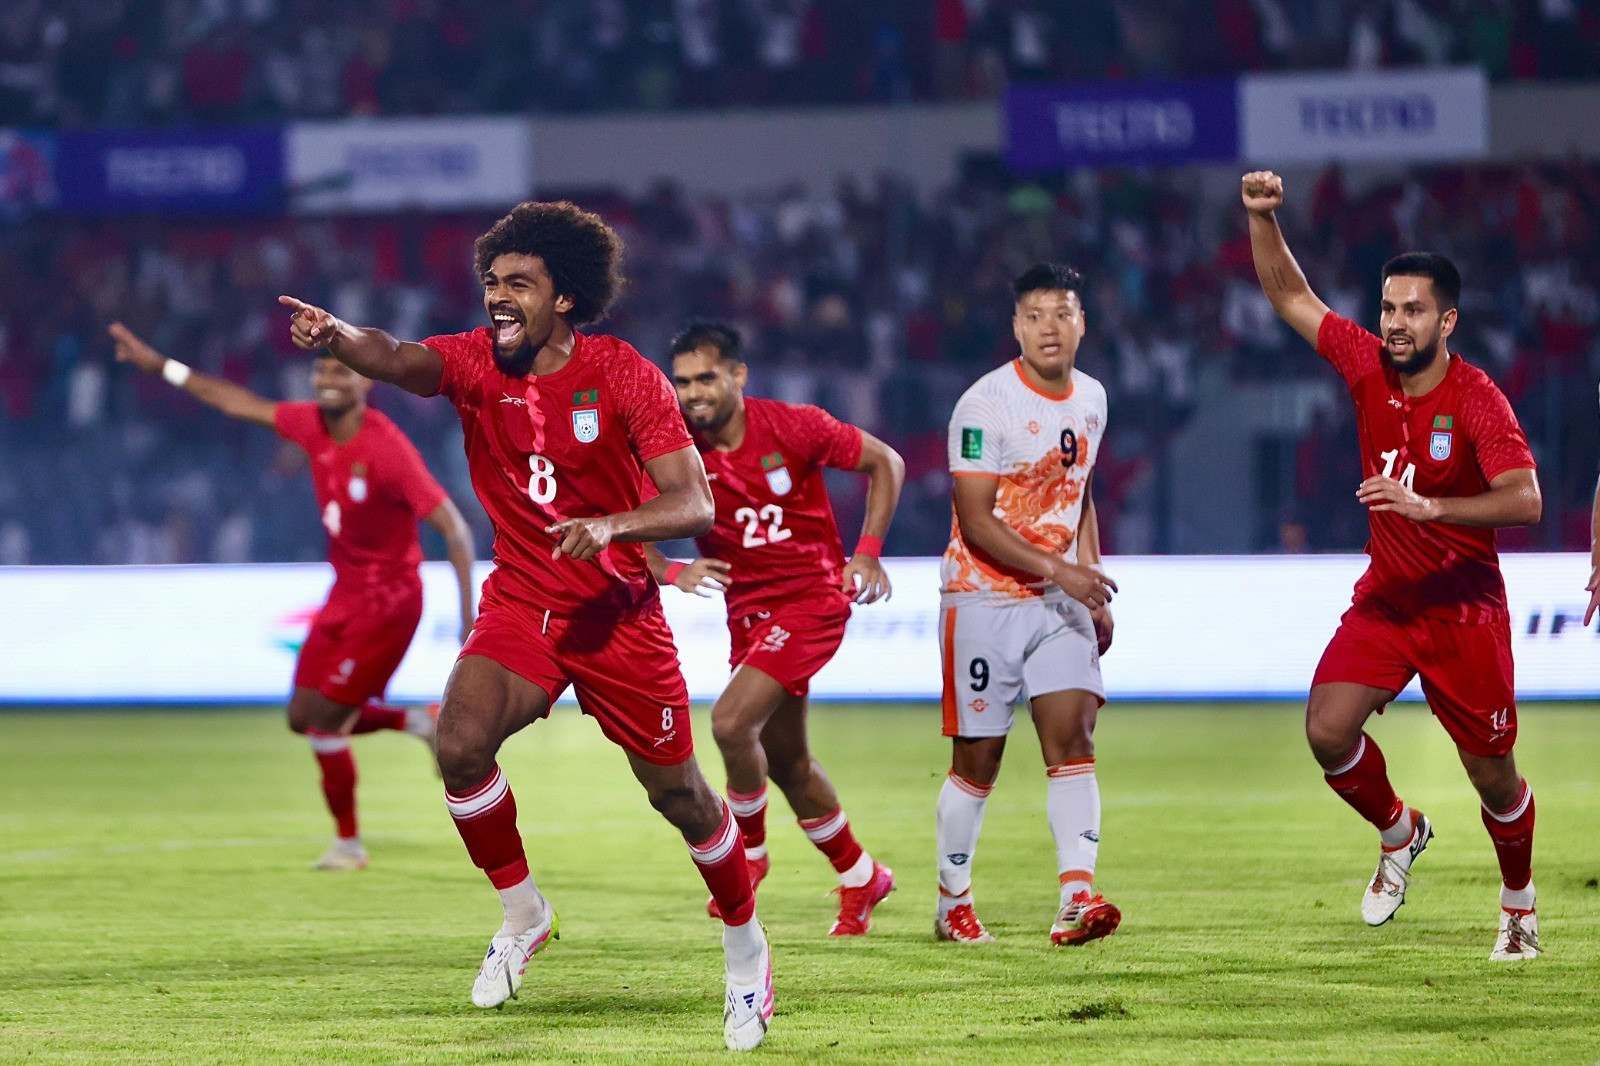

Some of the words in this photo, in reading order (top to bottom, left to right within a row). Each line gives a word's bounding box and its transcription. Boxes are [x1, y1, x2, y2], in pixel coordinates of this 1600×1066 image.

[1060, 428, 1078, 468] 9
[528, 454, 557, 504] 8
[734, 503, 793, 549] 22
[763, 625, 791, 649] 22
[969, 656, 990, 692] 9
[661, 706, 674, 731] 8
[1490, 707, 1508, 731] 14
